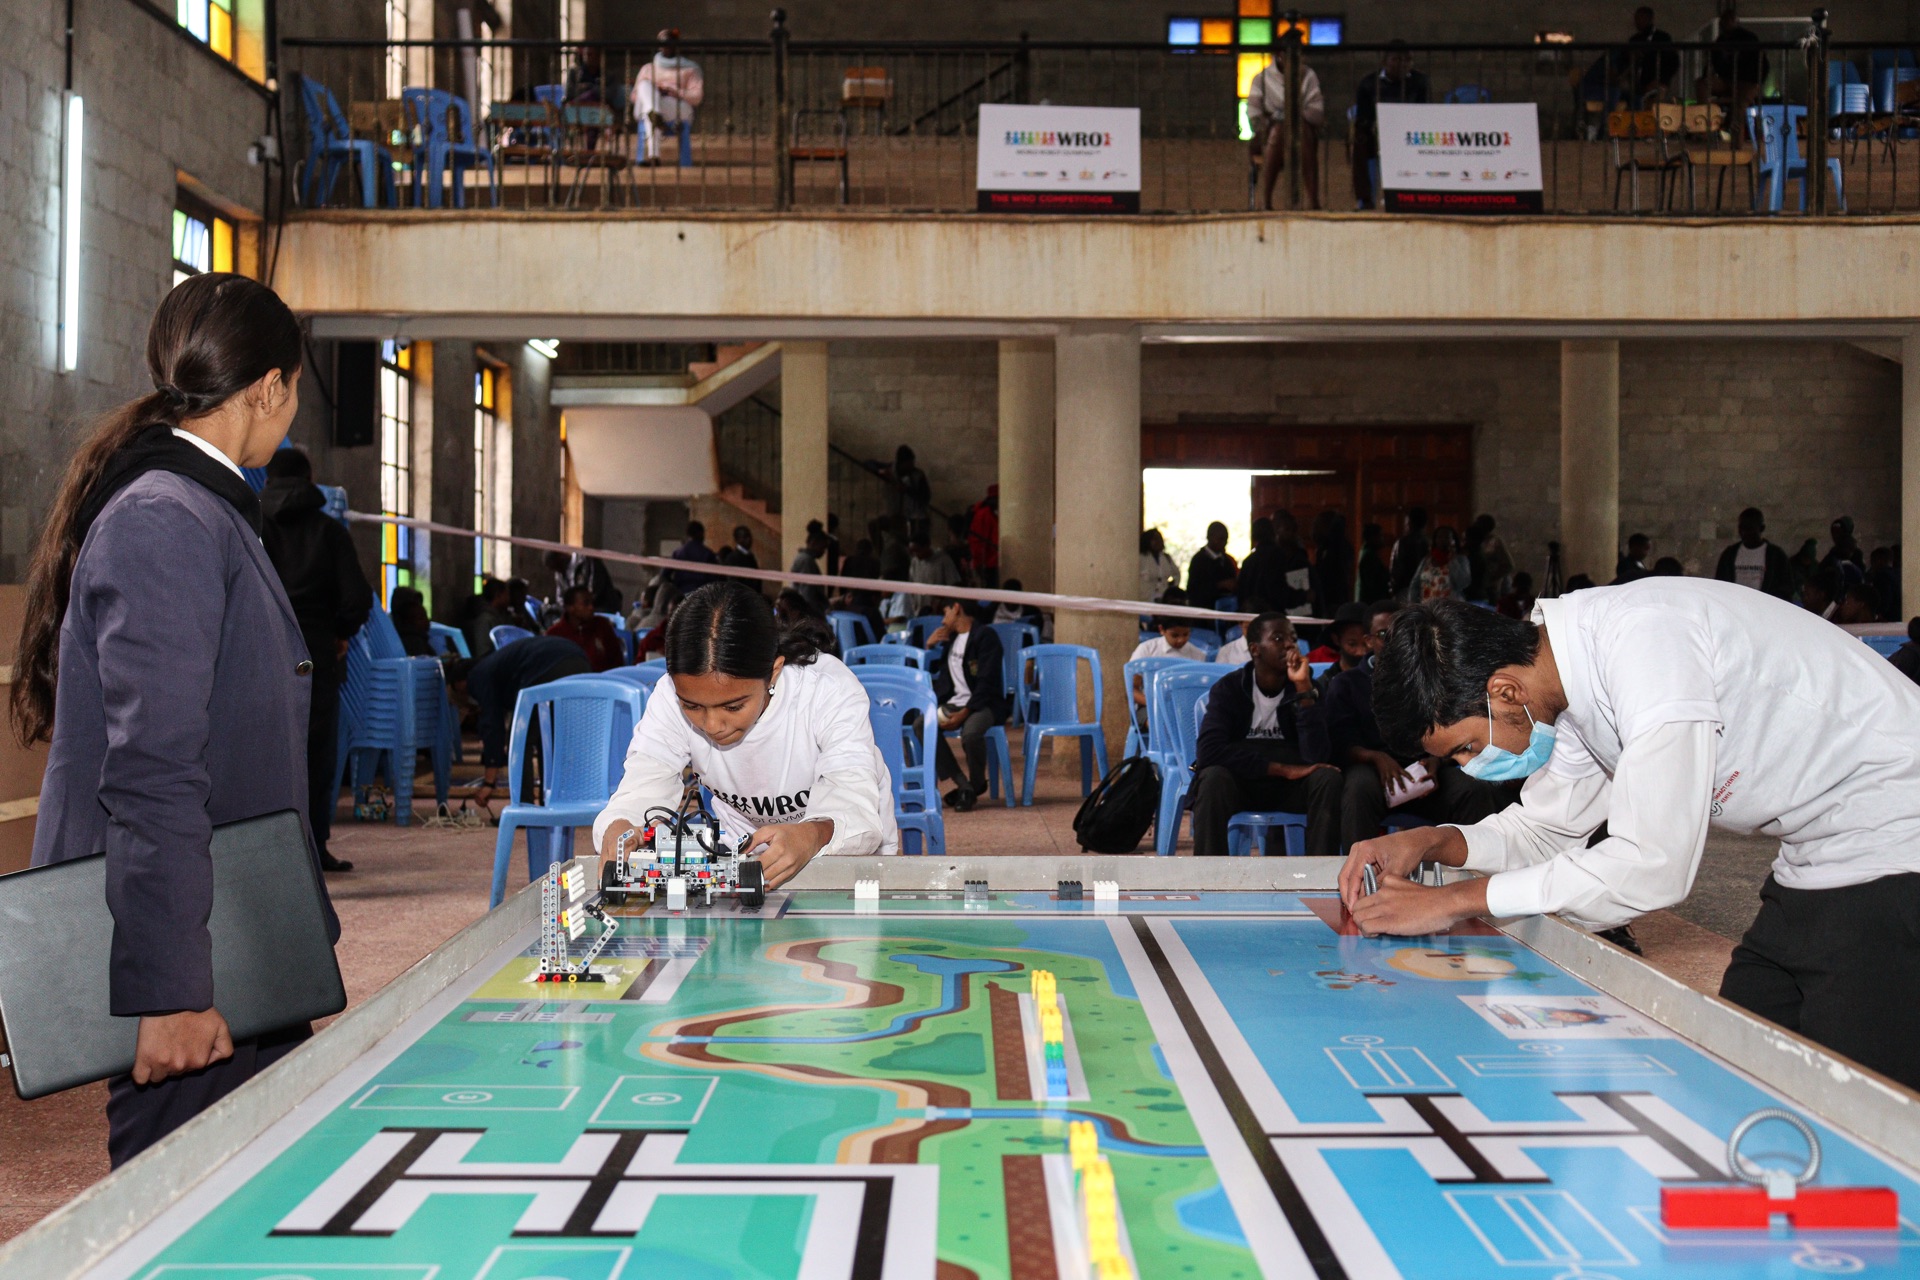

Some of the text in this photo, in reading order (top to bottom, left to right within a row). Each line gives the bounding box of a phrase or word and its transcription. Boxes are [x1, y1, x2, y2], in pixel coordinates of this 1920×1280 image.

[1057, 131, 1101, 147] WRO
[1457, 131, 1501, 147] WRO
[991, 194, 1009, 202] THE
[1012, 194, 1036, 203] WRO
[1398, 193, 1516, 203] THE WRO COMPETITIONS
[1724, 770, 1740, 787] CENTER
